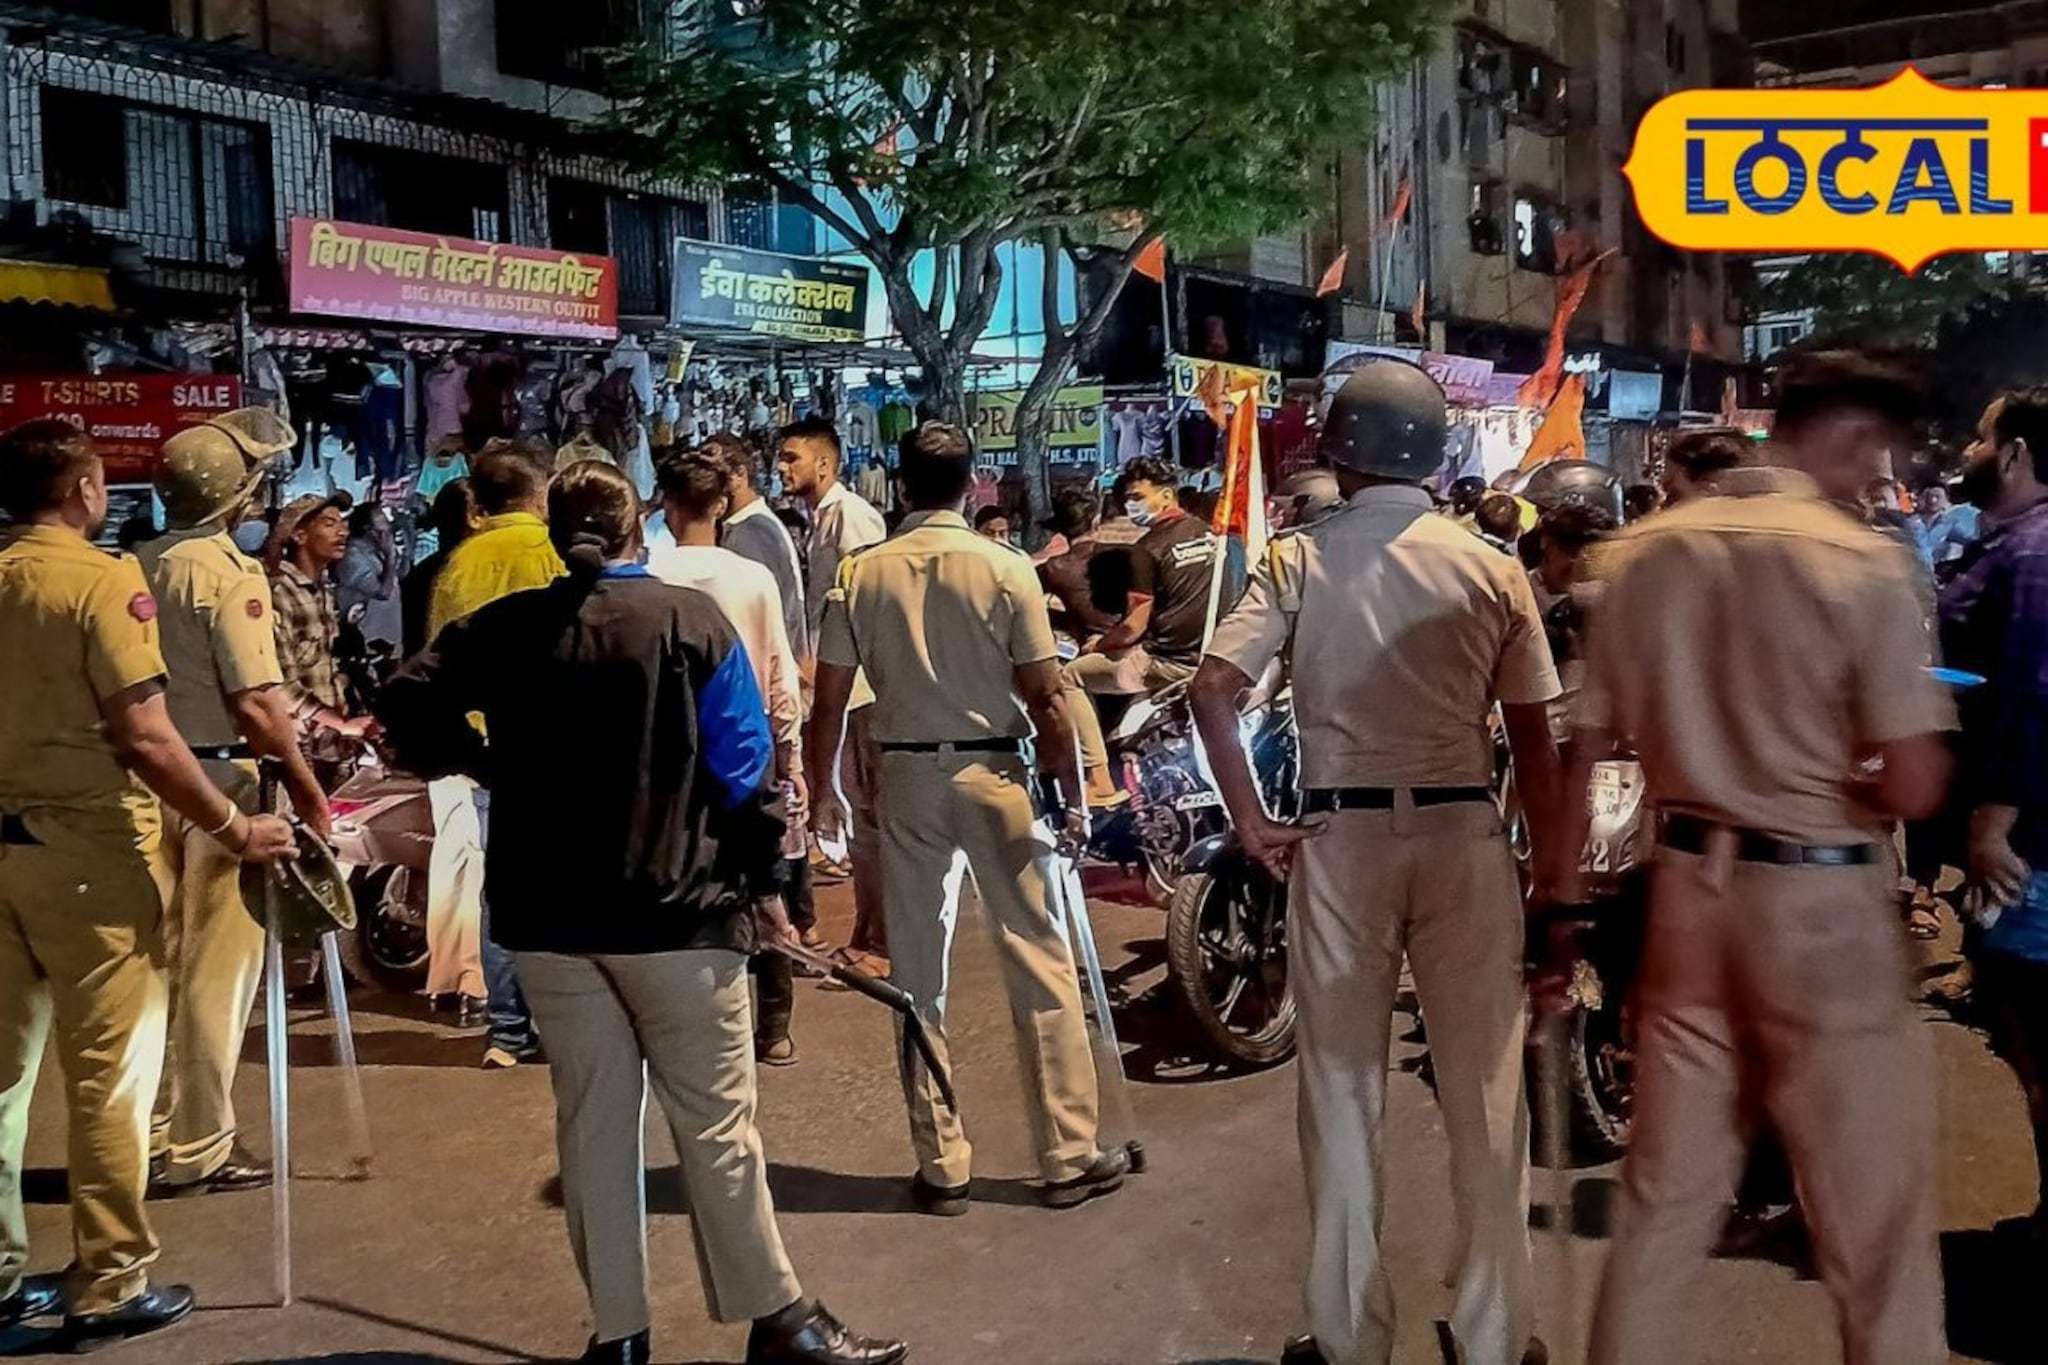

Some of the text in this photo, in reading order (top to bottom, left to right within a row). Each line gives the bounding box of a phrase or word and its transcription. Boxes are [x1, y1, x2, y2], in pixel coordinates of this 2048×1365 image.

[308, 222, 363, 272] बिग
[497, 255, 604, 299] आउटफिट
[700, 258, 746, 300] ईवा
[401, 284, 430, 303] BIG
[432, 287, 481, 309] APPLE
[484, 293, 552, 315] WESTERN
[553, 301, 601, 319] OUTFIT
[757, 305, 823, 324] COLLECTION
[40, 381, 140, 406] T-SHIRTS
[173, 385, 230, 407] SALE
[91, 422, 161, 439] onwards
